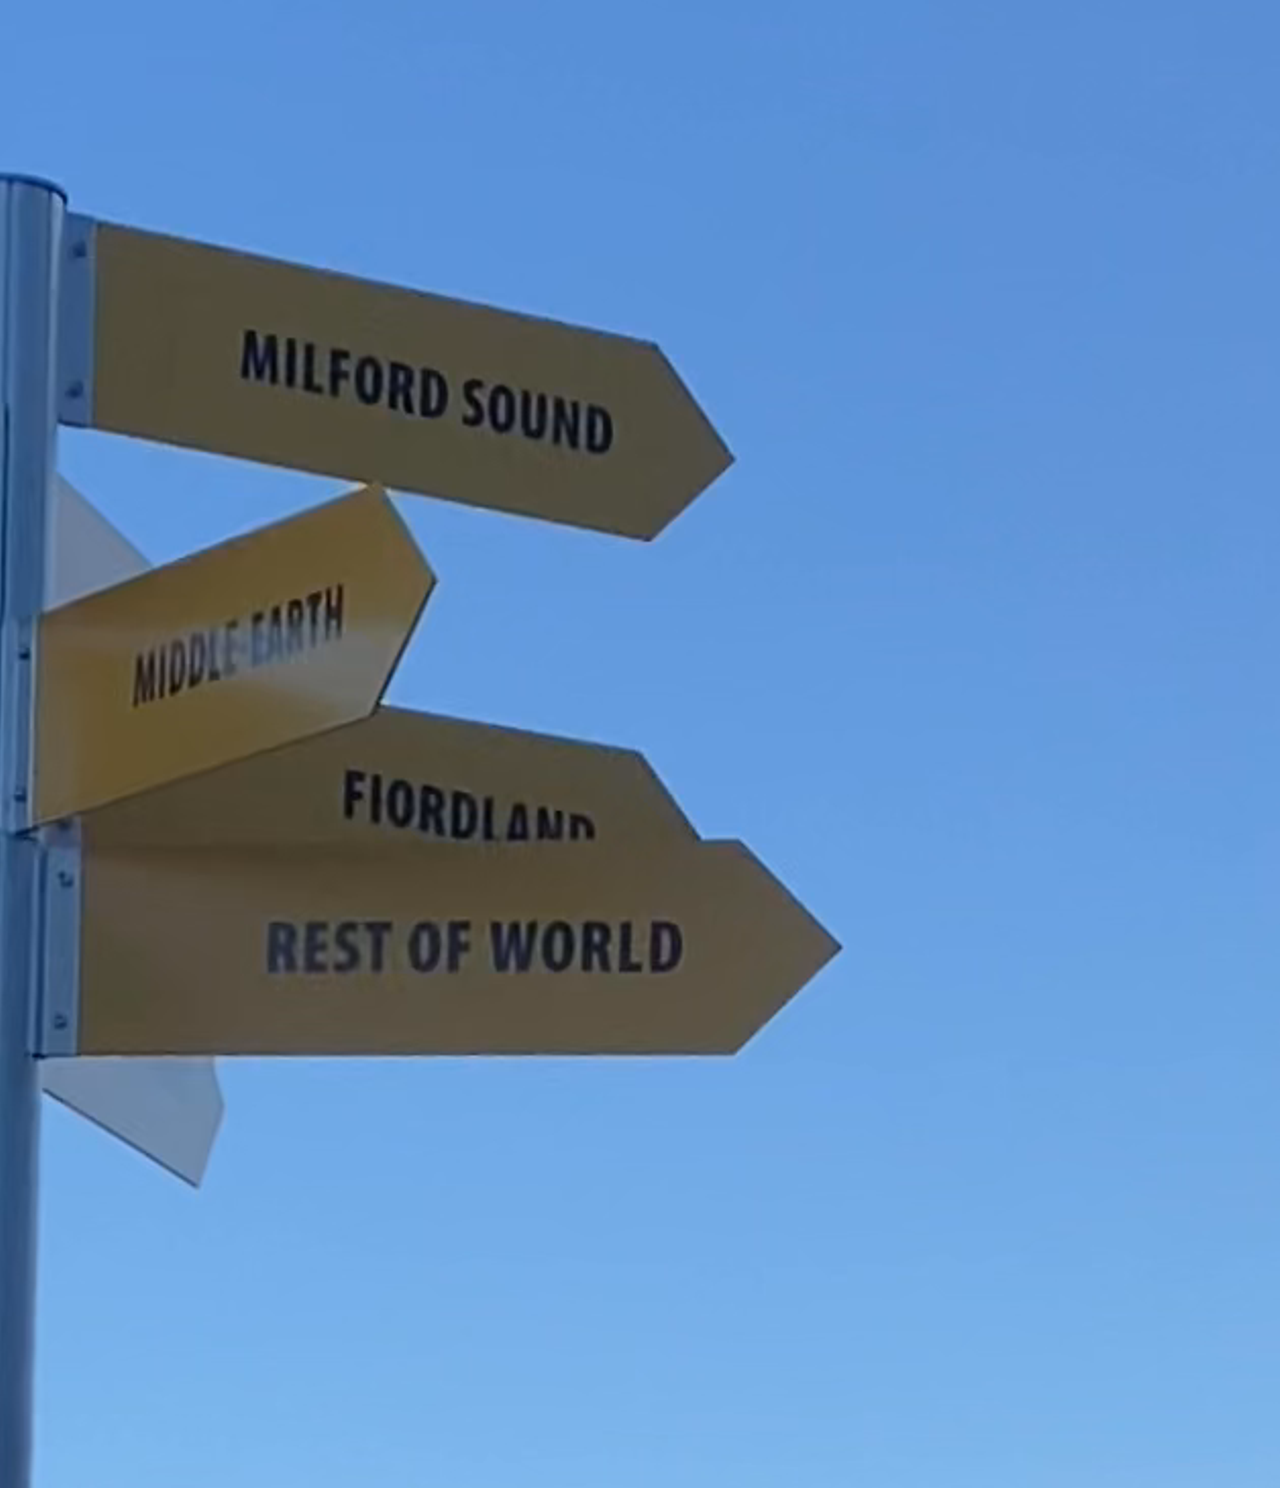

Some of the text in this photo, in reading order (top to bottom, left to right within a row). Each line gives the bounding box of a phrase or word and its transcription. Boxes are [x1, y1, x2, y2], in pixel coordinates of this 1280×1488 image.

[241, 329, 614, 454] MILFORD SOUND
[266, 921, 684, 974] REST OF WORLD
